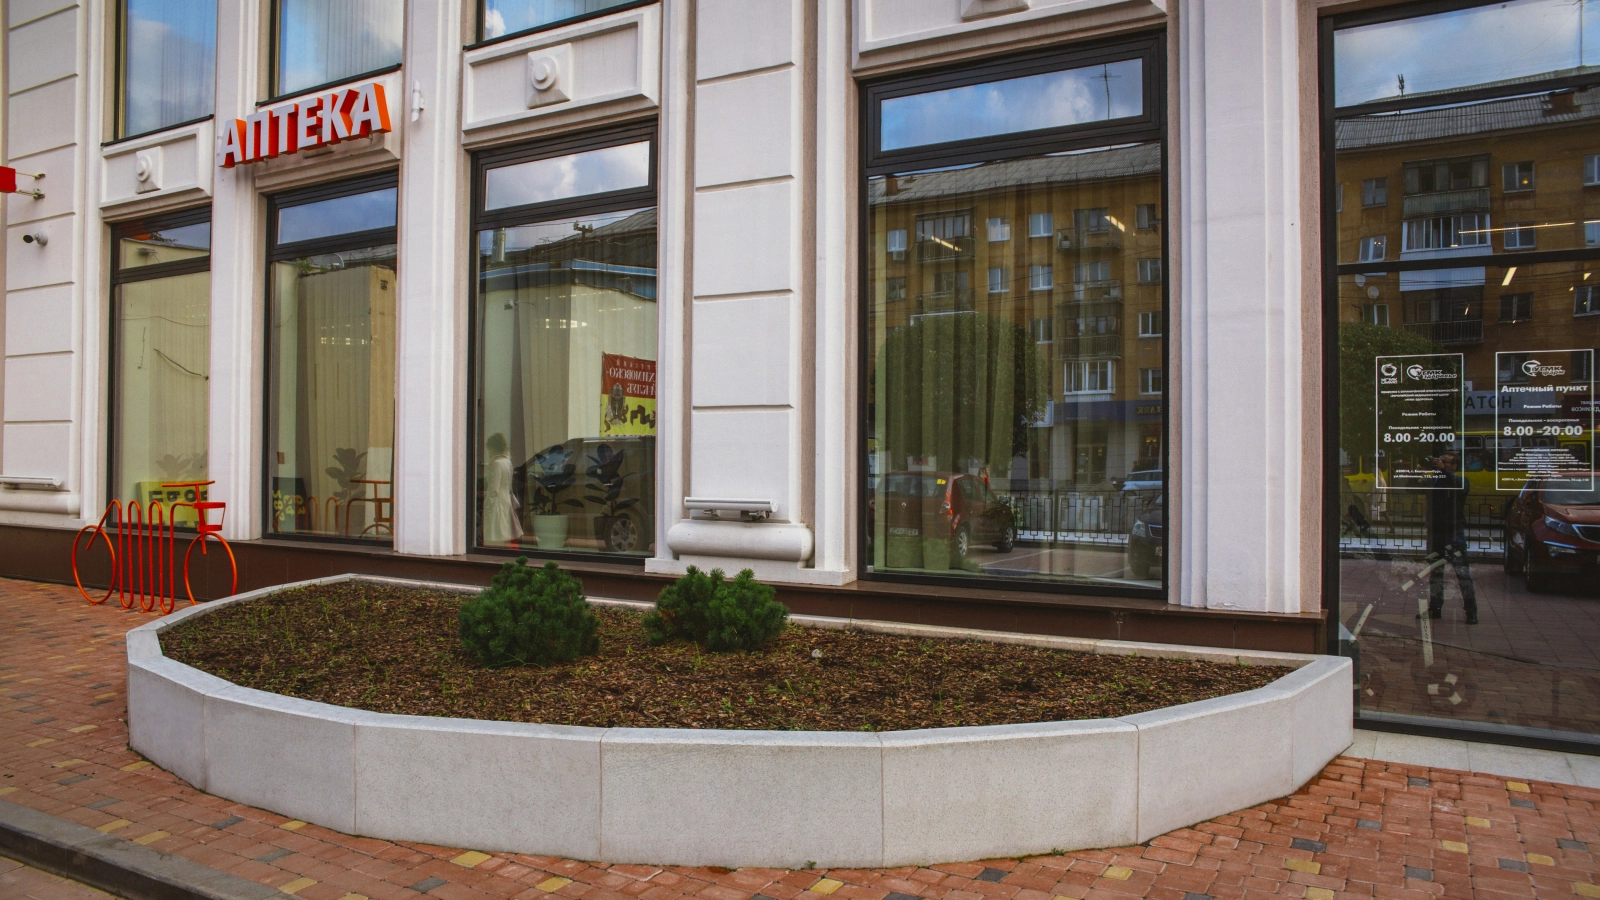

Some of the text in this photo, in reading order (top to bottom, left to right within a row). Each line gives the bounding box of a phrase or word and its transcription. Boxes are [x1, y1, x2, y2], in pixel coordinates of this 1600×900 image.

[218, 82, 391, 168] АПТЕКА
[1555, 385, 1588, 393] пункт
[1503, 426, 1533, 436] 8.00
[1383, 432, 1411, 443] 8.00
